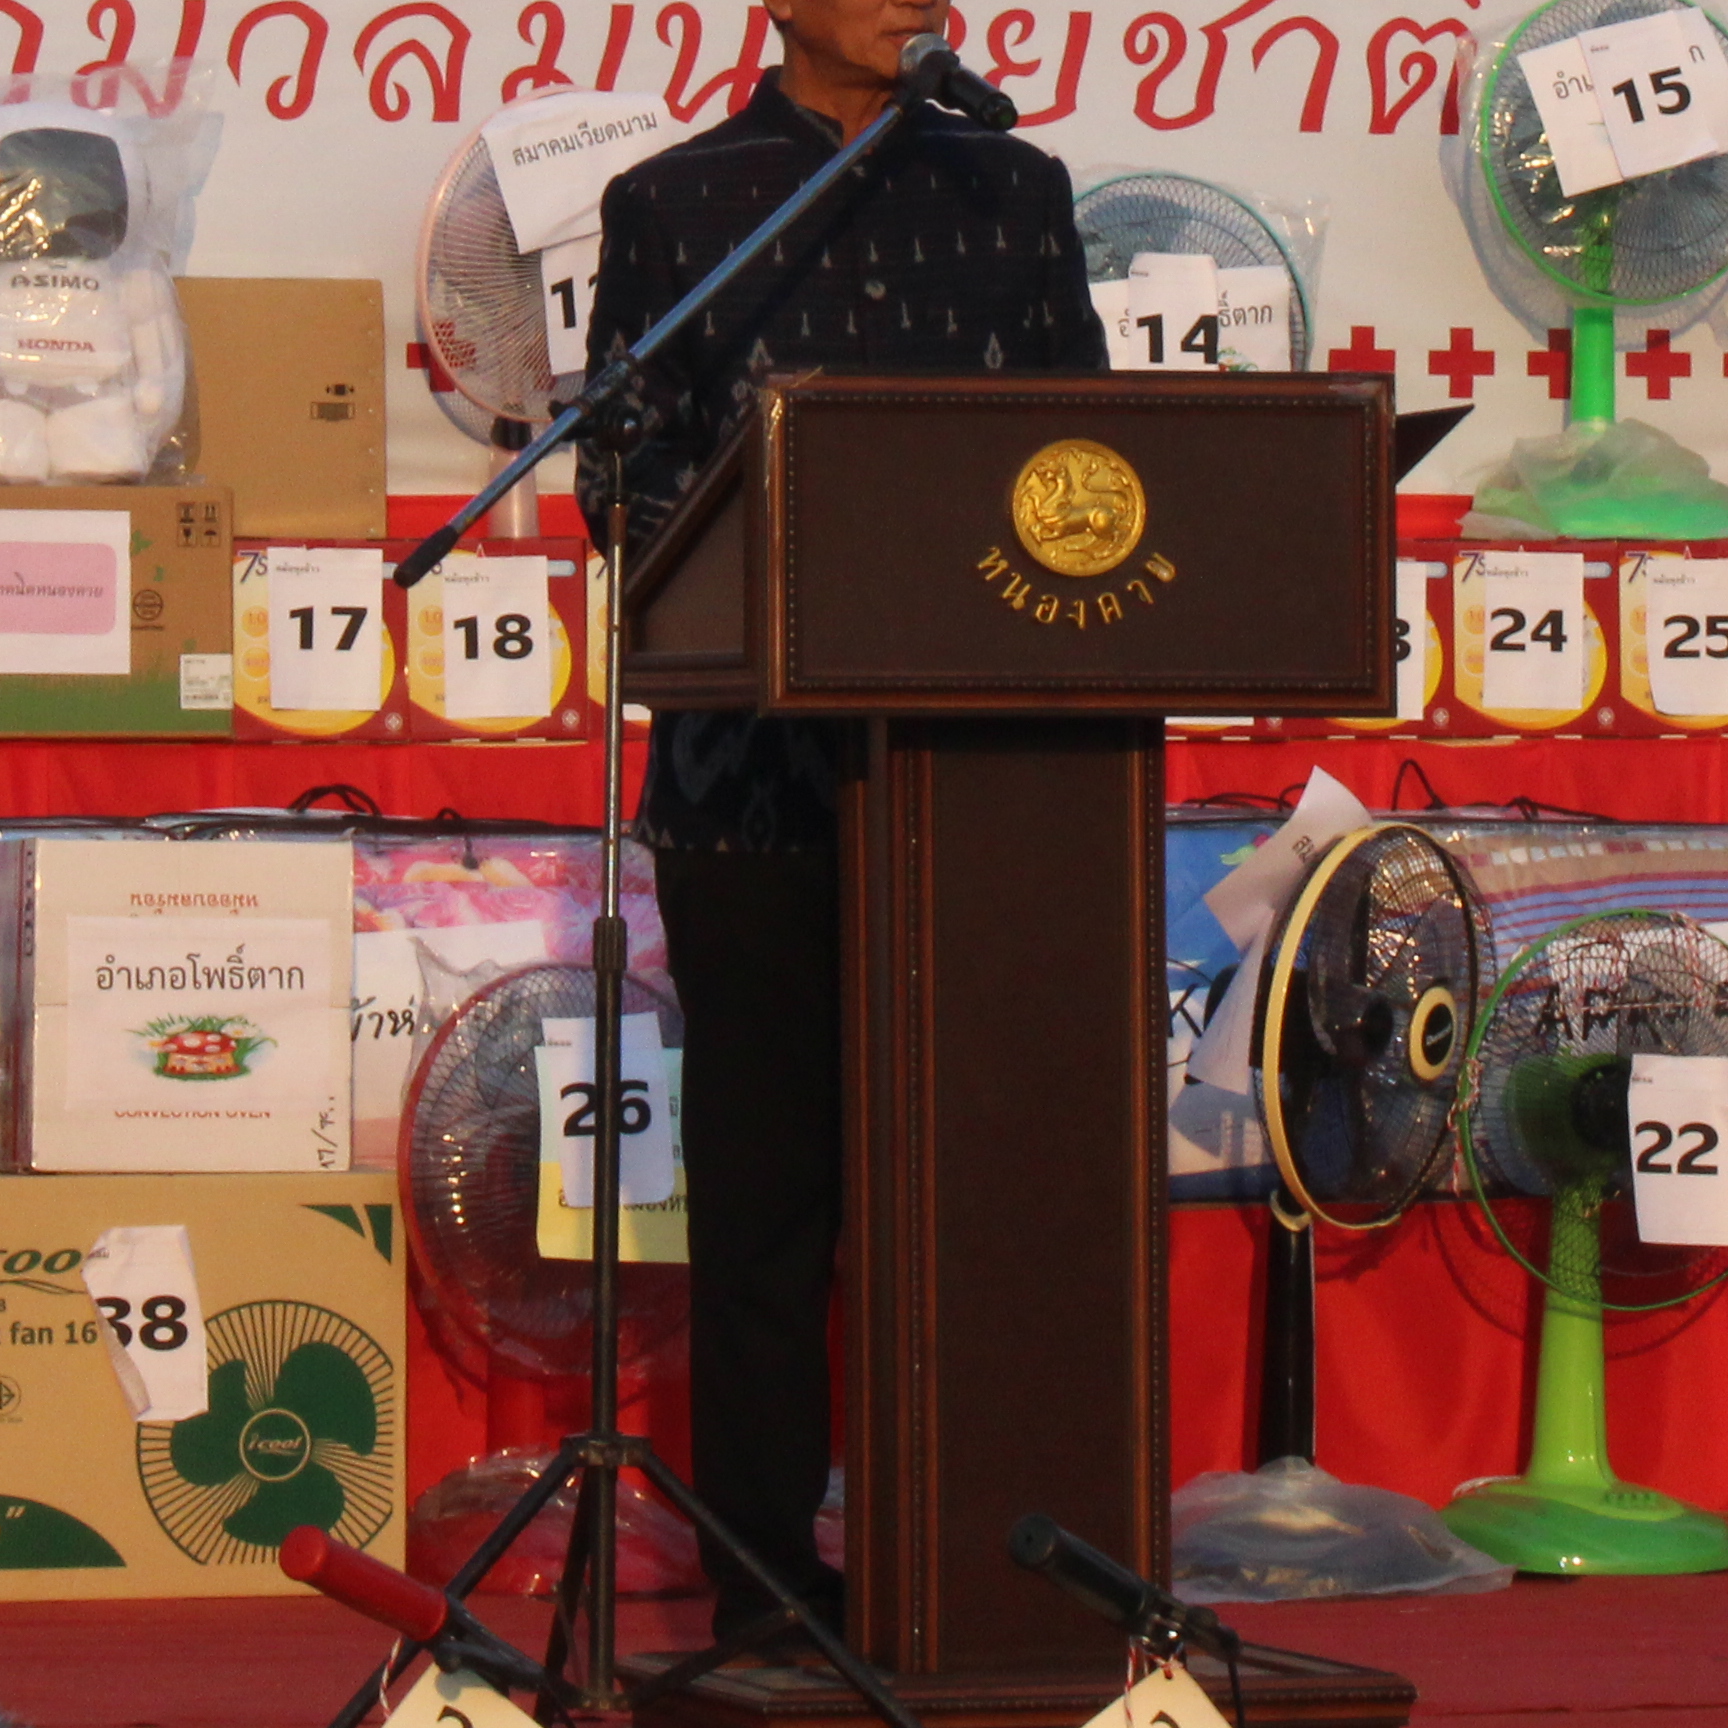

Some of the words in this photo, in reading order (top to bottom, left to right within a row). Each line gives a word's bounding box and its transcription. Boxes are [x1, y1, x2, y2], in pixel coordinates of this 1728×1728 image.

[1611, 66, 1693, 123] 15
[512, 110, 659, 167] สมาคมเวียดนาม
[11, 273, 100, 291] ASIMO
[17, 337, 95, 354] HONDA
[1136, 313, 1220, 364] 14
[288, 605, 368, 651] 17
[454, 613, 534, 661] 18
[1490, 608, 1567, 653] 24
[96, 942, 306, 992] อำเภอโพธิ์ตาก
[560, 1080, 653, 1139] 26
[1634, 1120, 1720, 1176] 22
[10, 1322, 54, 1346] fan
[248, 1431, 303, 1454] icool
